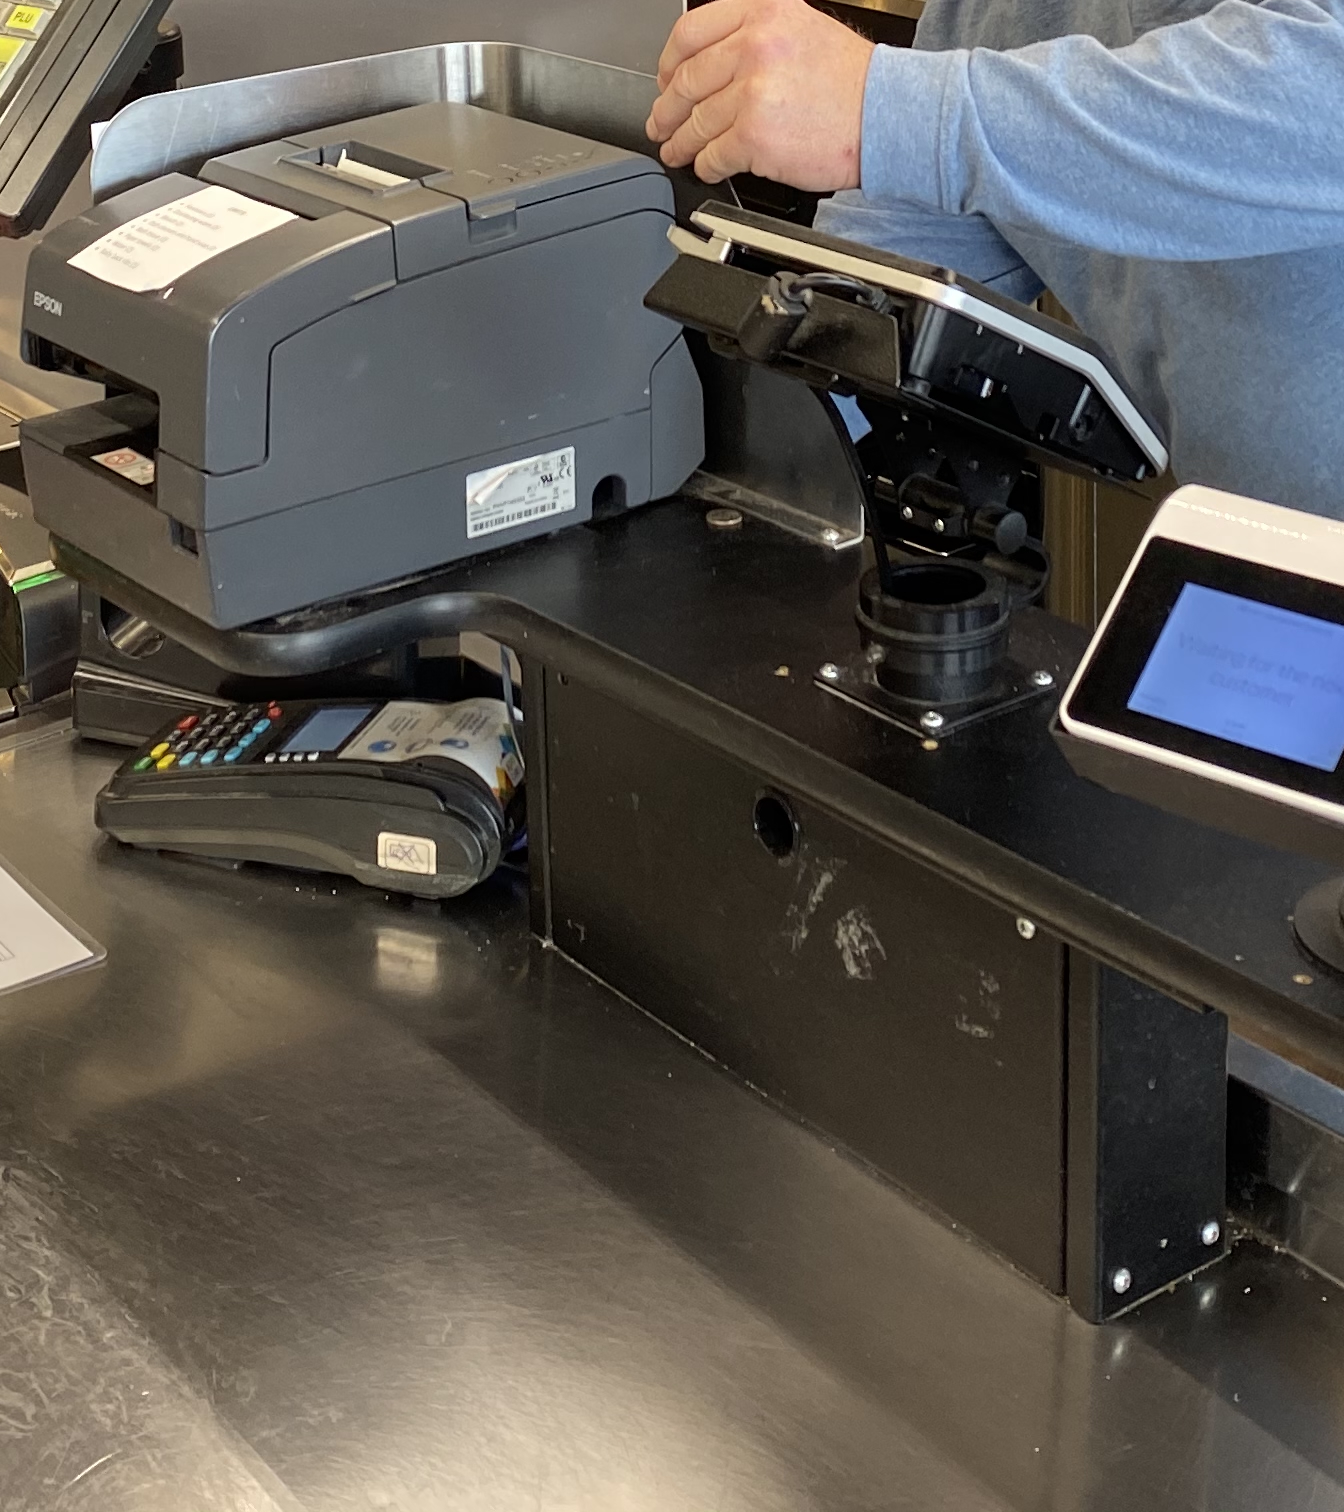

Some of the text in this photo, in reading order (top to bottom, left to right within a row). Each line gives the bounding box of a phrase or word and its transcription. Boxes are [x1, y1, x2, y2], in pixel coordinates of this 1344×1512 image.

[13, 11, 35, 24] PLU
[34, 290, 63, 317] EPSON
[1208, 671, 1294, 707] customer
